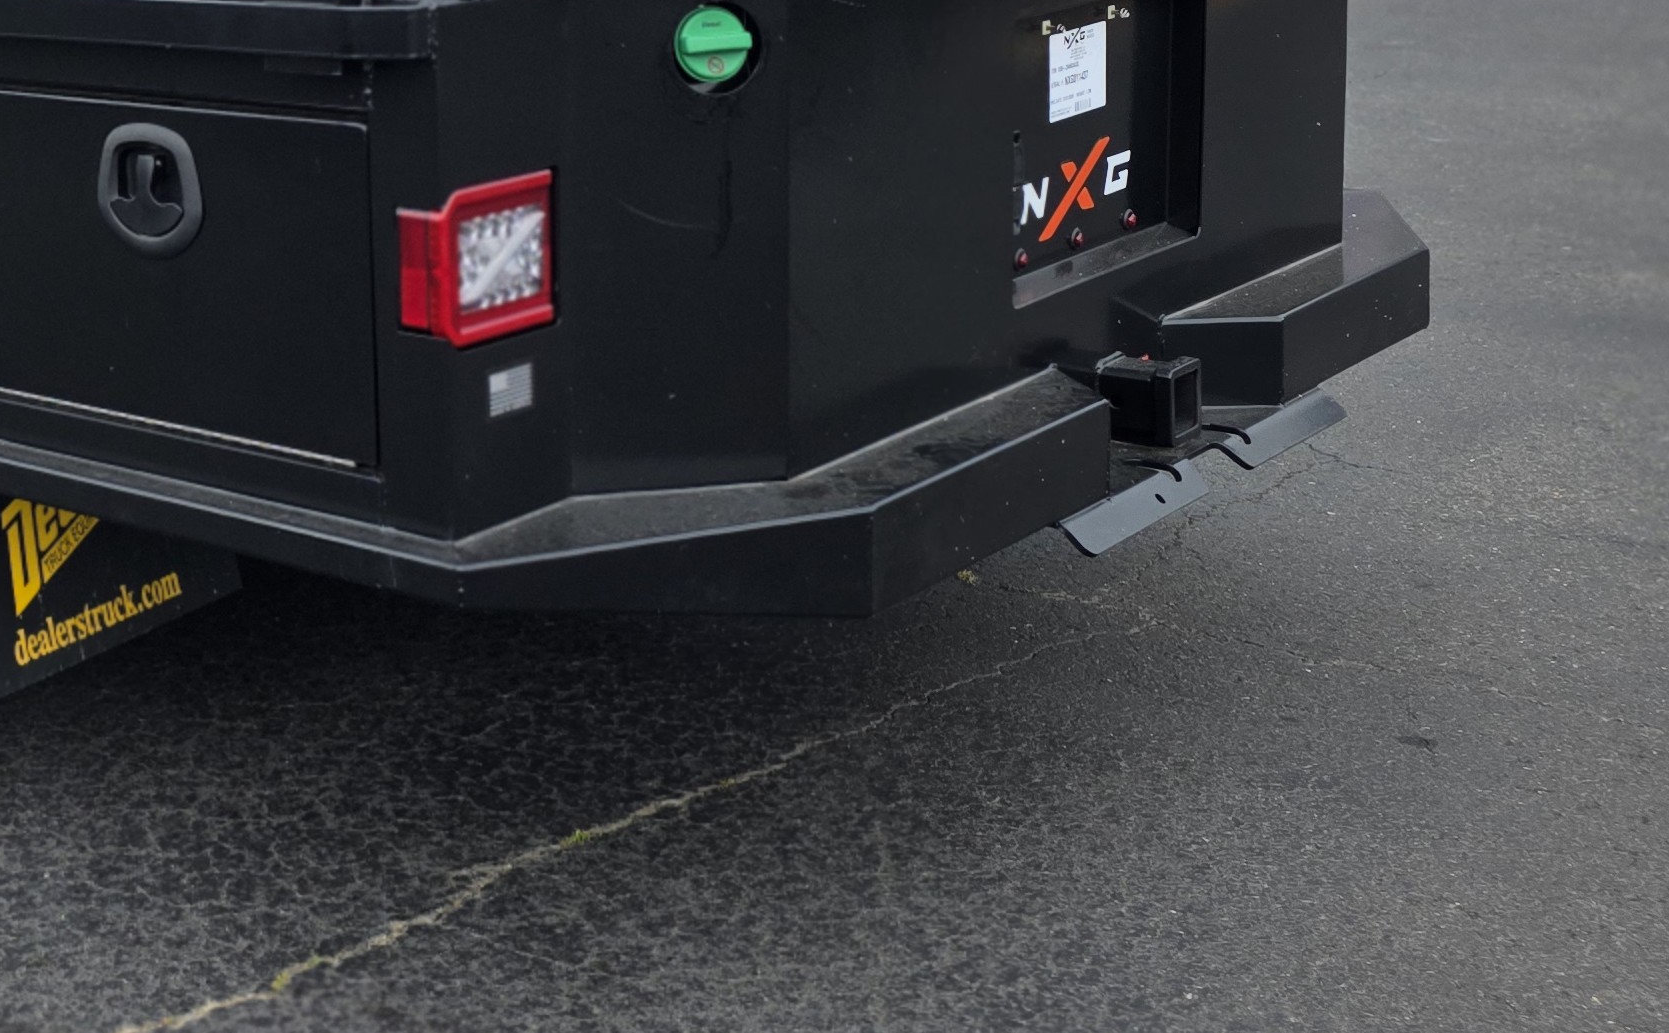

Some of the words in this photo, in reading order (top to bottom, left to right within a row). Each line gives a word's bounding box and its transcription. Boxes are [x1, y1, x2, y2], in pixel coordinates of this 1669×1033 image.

[1064, 27, 1086, 50] NXG
[1020, 136, 1131, 242] NXG
[14, 572, 182, 667] dealerstruck.com
